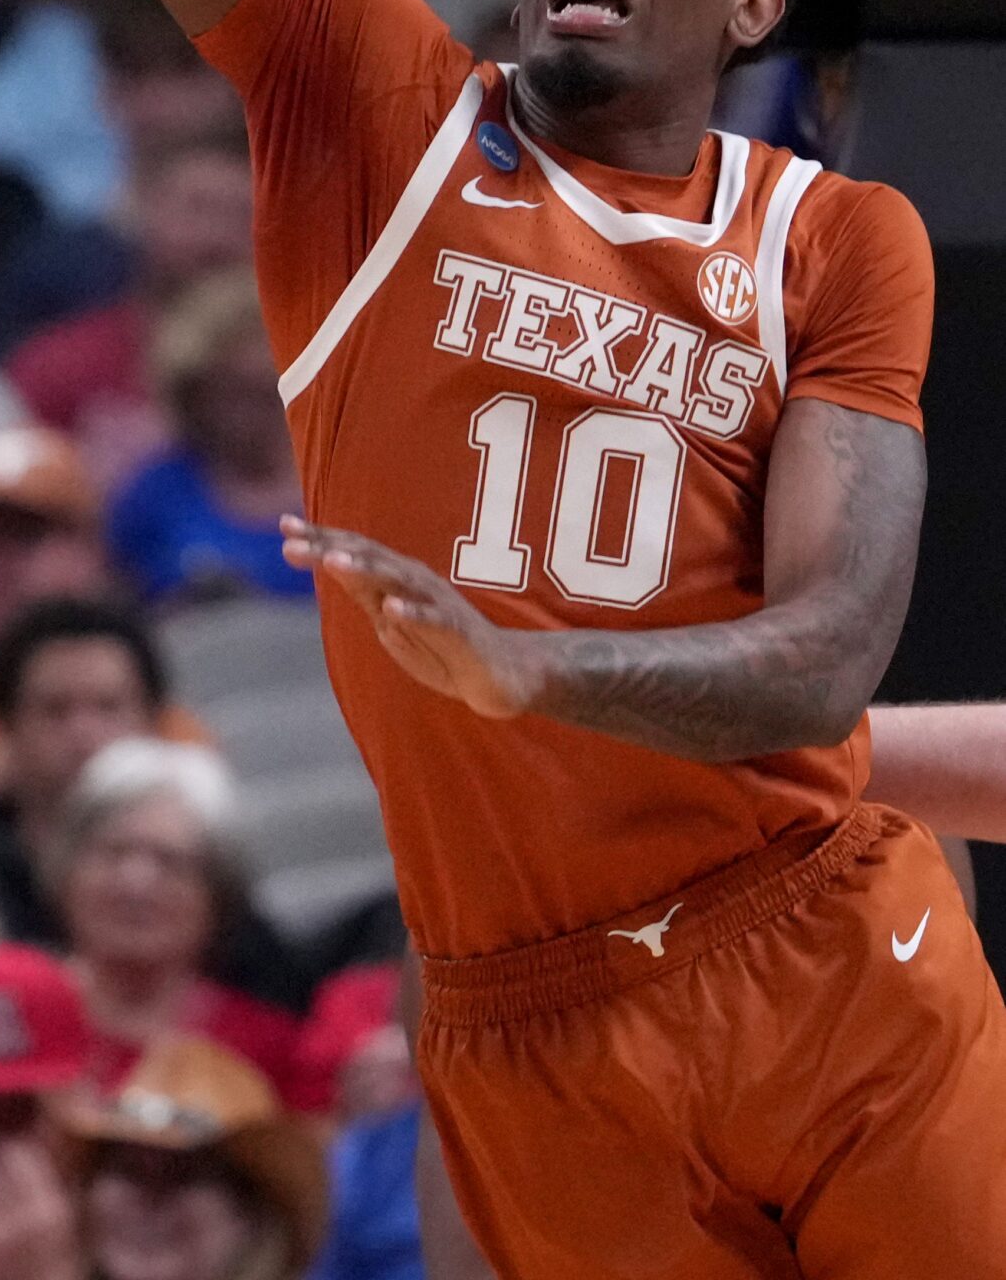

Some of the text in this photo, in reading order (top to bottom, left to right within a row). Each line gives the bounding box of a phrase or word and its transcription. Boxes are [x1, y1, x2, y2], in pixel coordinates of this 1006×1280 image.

[432, 249, 772, 440] TEXAS
[703, 257, 754, 320] SEC
[450, 391, 686, 610] 10
